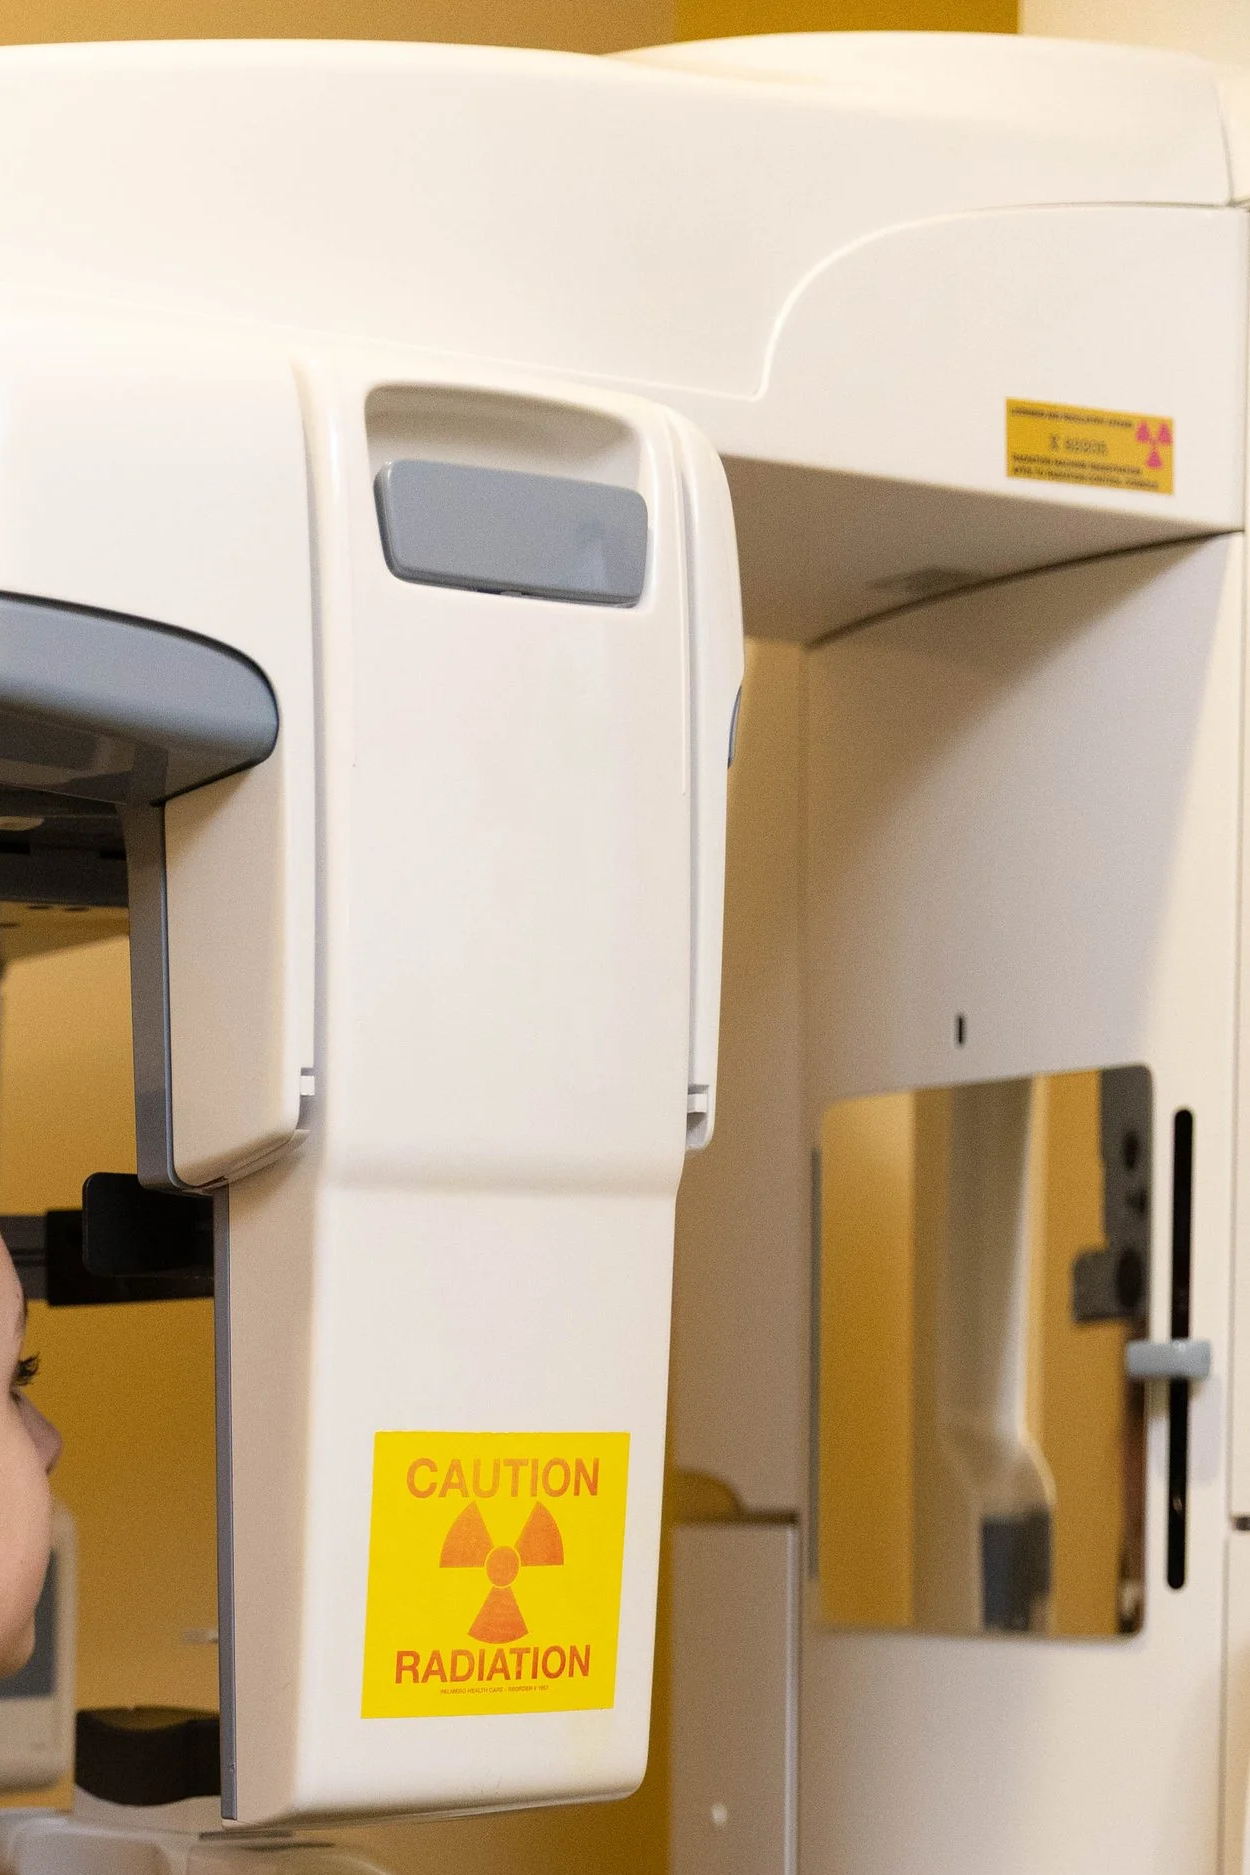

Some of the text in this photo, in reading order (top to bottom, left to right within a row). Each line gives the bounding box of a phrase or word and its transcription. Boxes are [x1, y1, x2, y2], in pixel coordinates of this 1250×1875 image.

[406, 1457, 600, 1499] CAUTION
[395, 1644, 591, 1684] RADIATION
[467, 1686, 488, 1694] HEALTH
